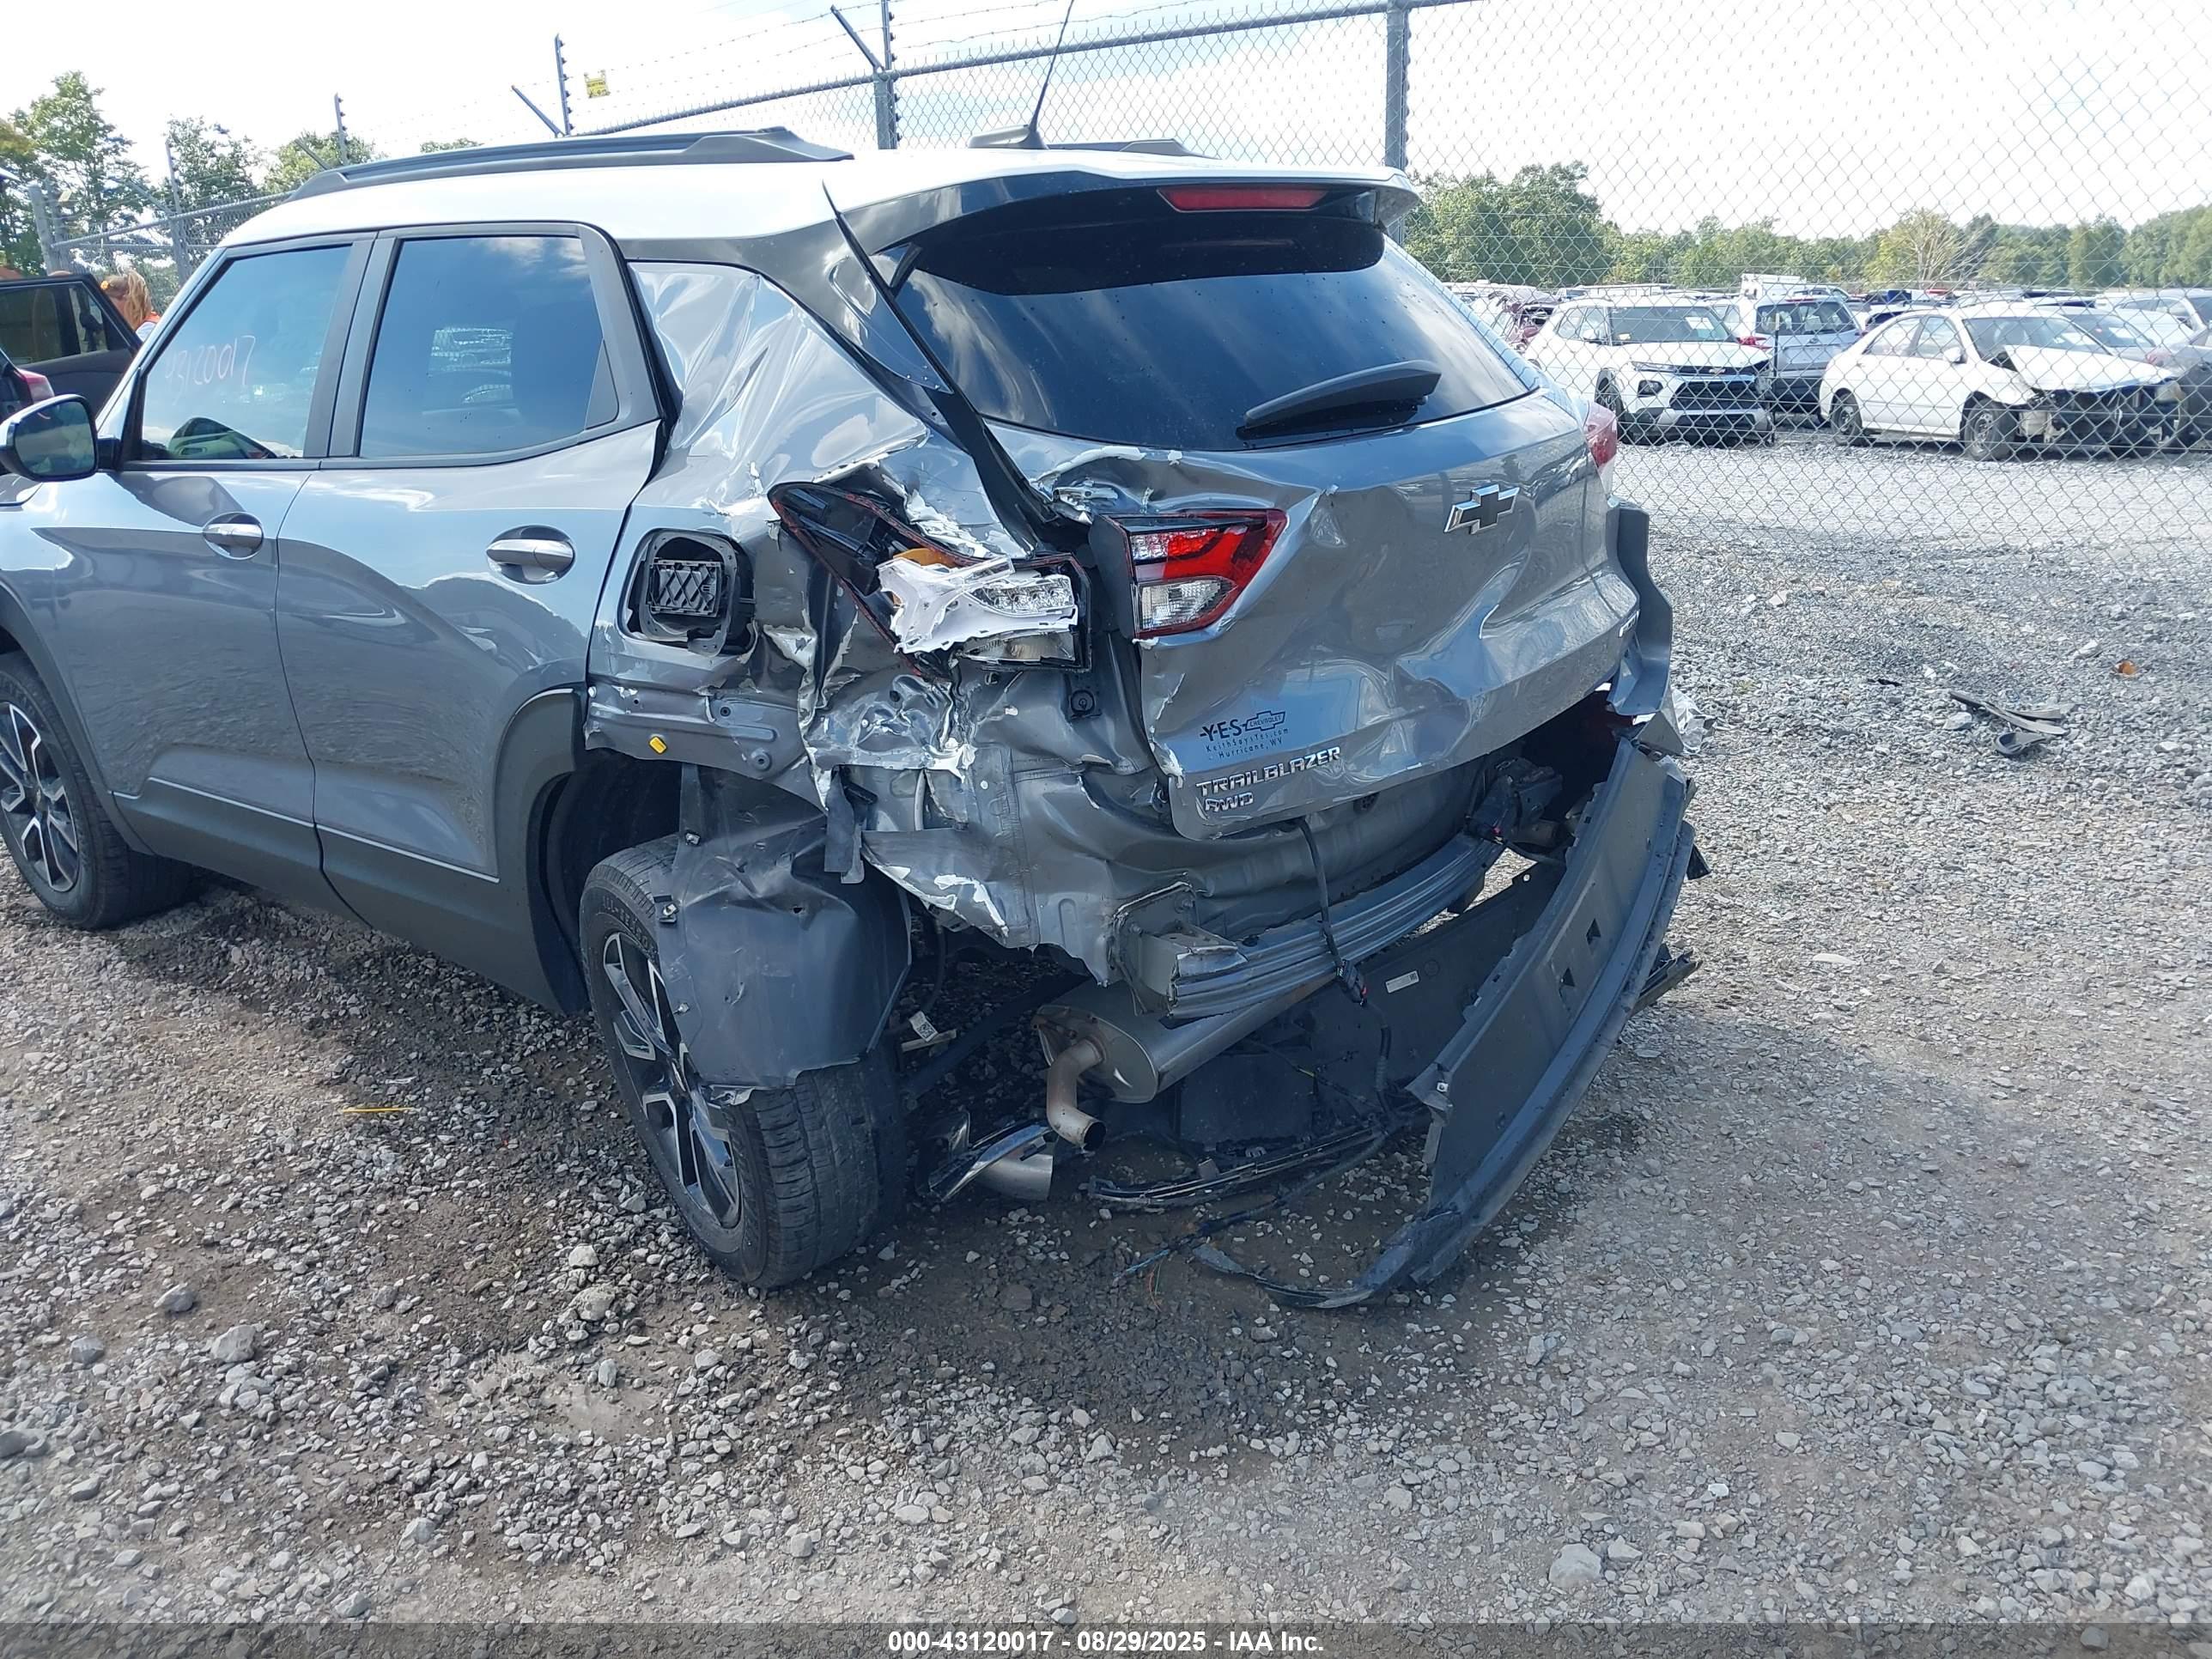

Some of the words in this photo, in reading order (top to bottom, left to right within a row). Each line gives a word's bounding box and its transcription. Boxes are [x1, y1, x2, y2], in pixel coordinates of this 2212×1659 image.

[1249, 714, 1282, 727] CHEVROLET
[1218, 743, 1269, 759] Hurricane,
[1269, 737, 1283, 747] WV
[1195, 745, 1341, 798] TRAILBLAZER
[1205, 792, 1254, 812] AWD
